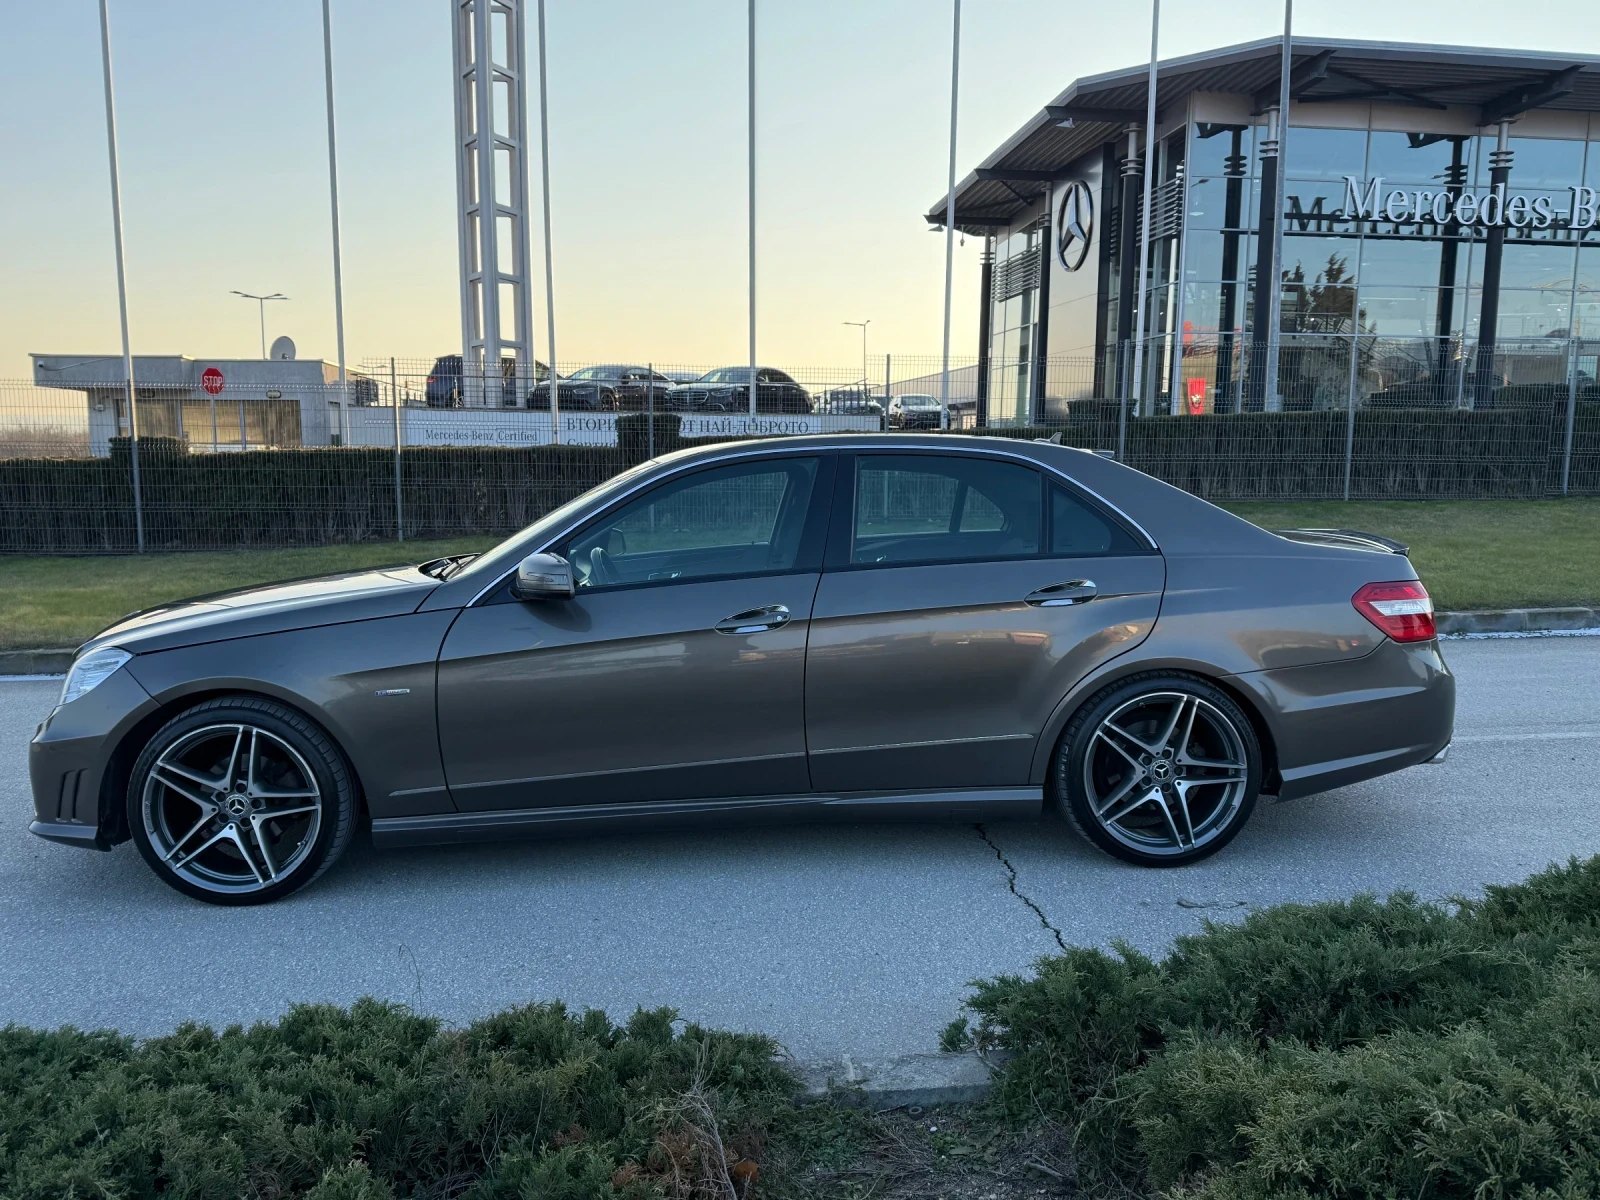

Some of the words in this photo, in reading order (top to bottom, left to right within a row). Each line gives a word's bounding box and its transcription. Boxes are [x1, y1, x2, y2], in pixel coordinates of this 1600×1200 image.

[1339, 175, 1600, 229] Mercedes-B
[203, 375, 223, 386] STOP
[700, 418, 809, 434] НАЙ-ДОБРОТО
[425, 429, 494, 440] Mercedes-Benz
[498, 430, 537, 441] Certified
[1208, 691, 1239, 718] RADIAL
